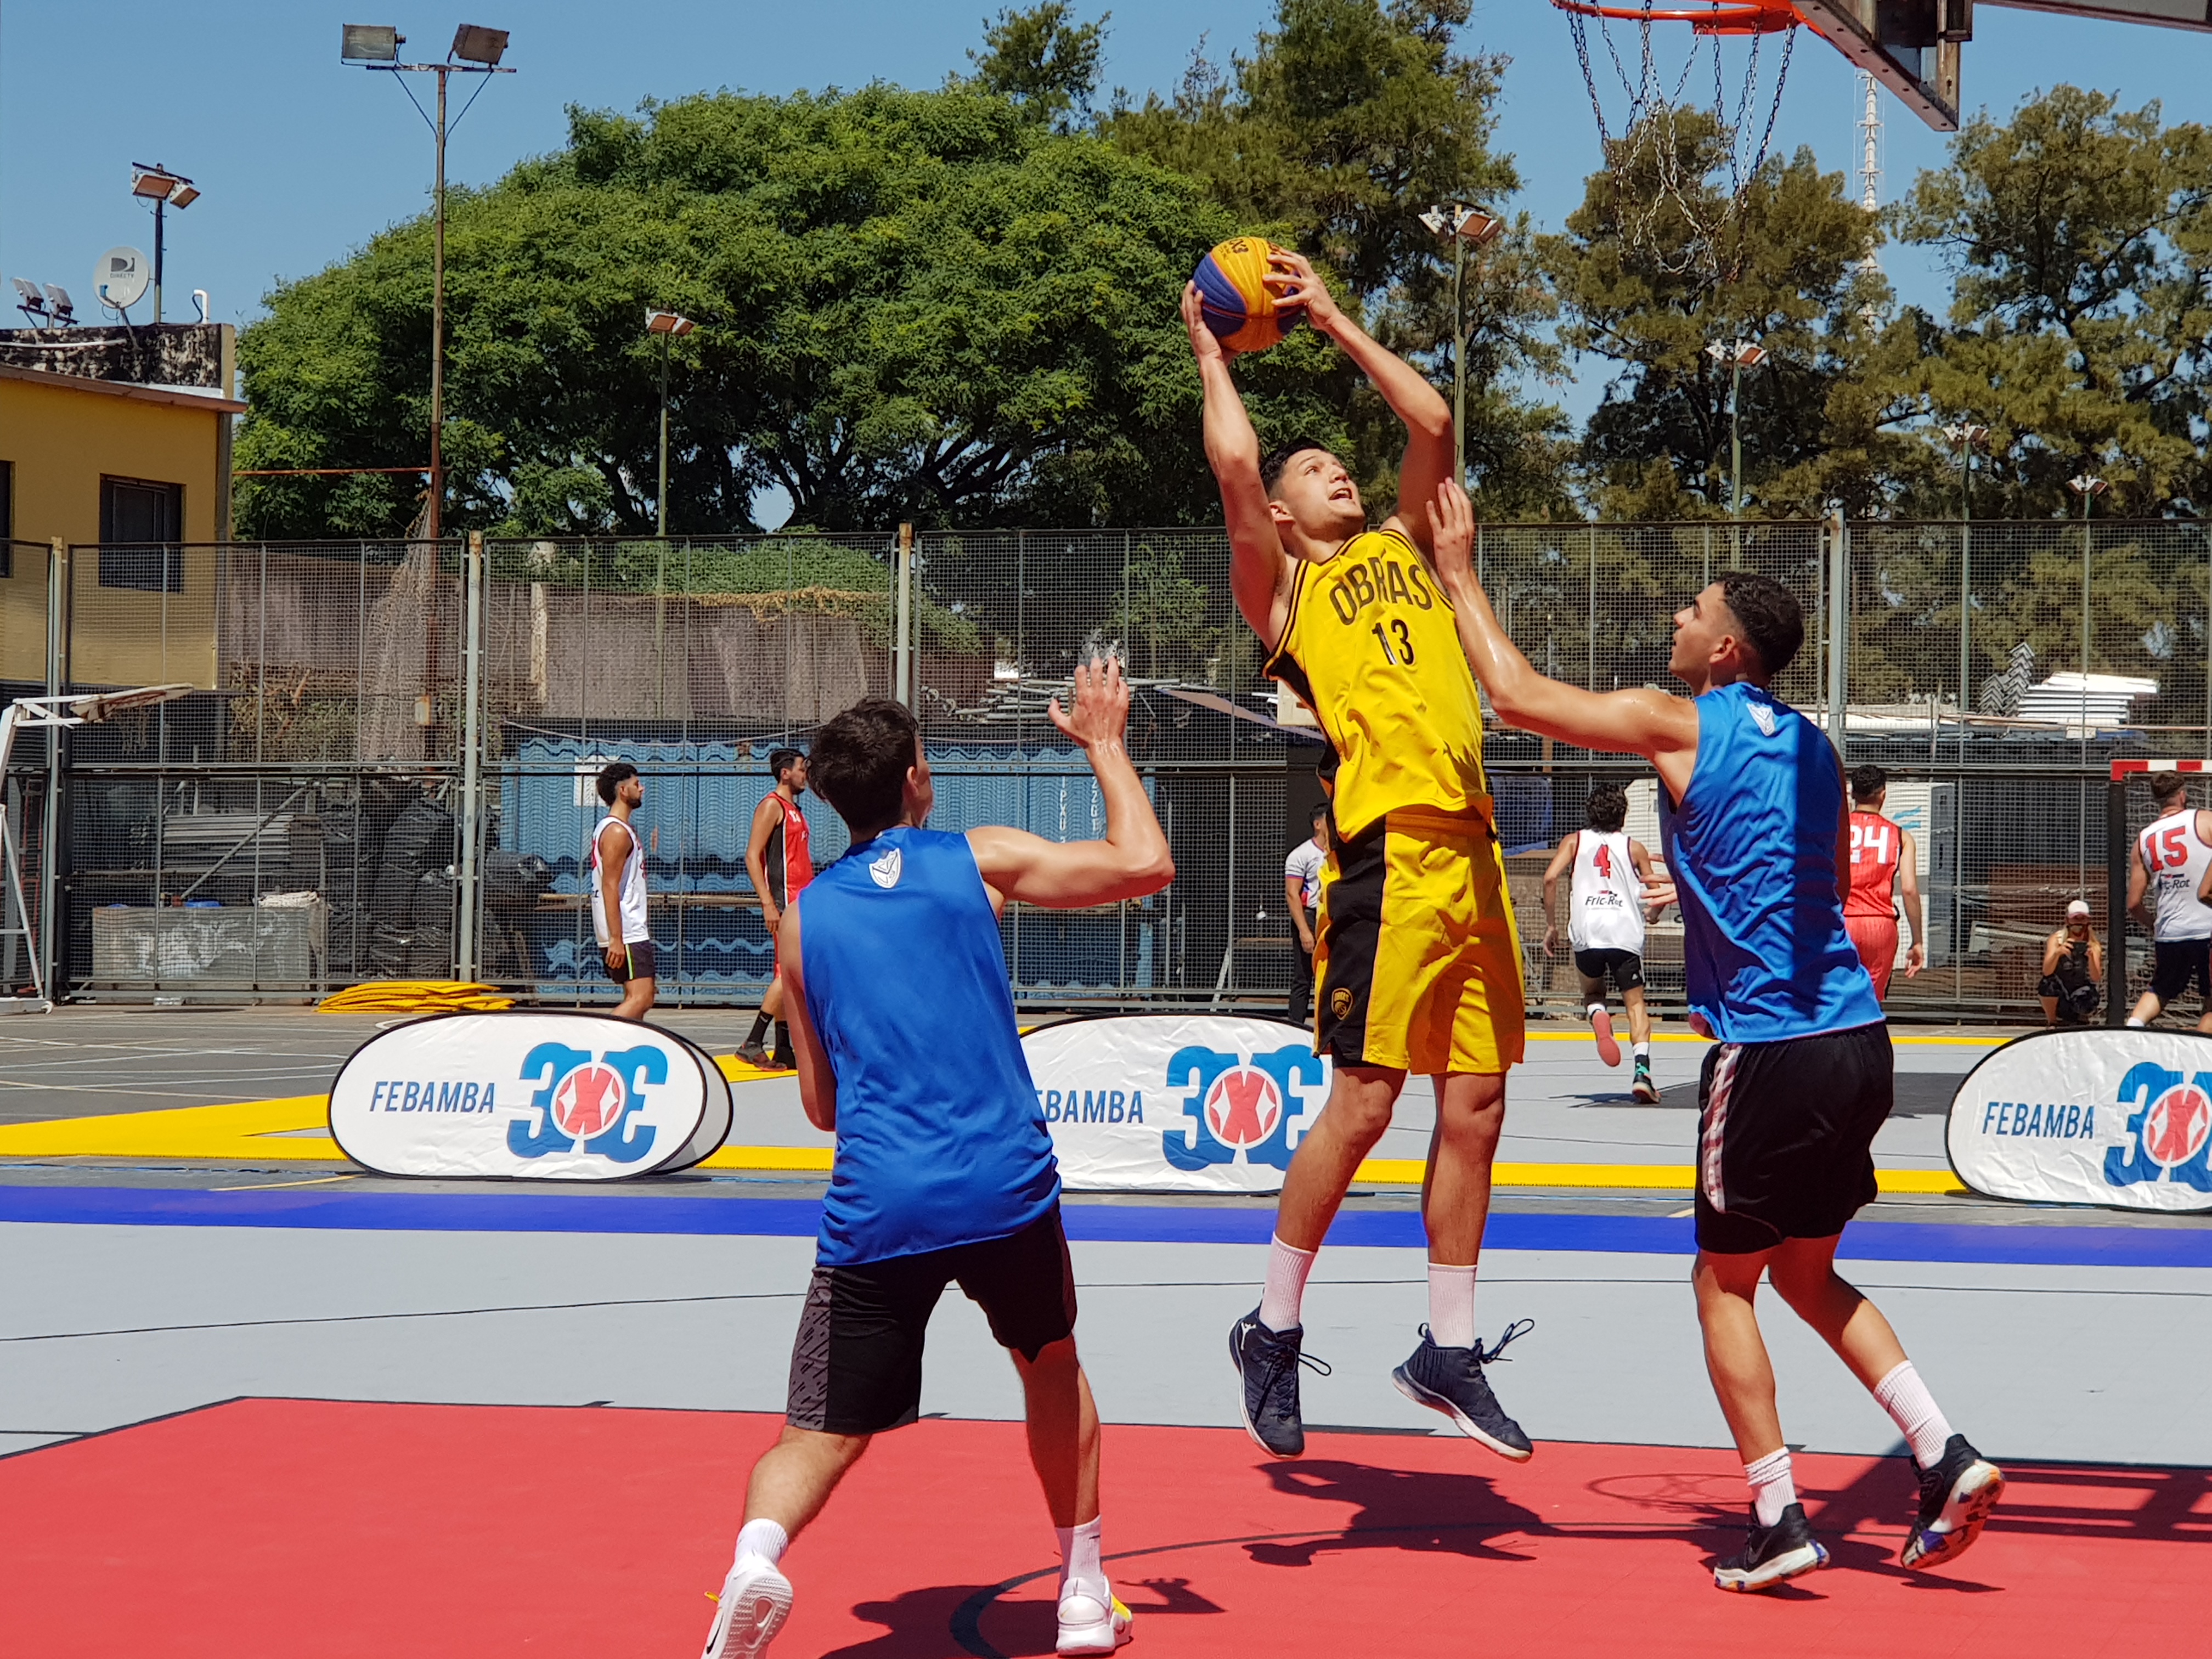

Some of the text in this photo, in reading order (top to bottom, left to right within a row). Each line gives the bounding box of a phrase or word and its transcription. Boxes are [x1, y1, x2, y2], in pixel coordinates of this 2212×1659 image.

[1329, 557, 1432, 625] OBRAS
[1372, 619, 1414, 665] 13
[1593, 844, 1611, 879] 4
[1850, 825, 1889, 864] 24
[2146, 826, 2188, 872] 15
[369, 1081, 495, 1113] FEBAMBA
[1035, 1089, 1144, 1124] BAMBA
[1982, 1102, 2095, 1139] FEBAMBA
